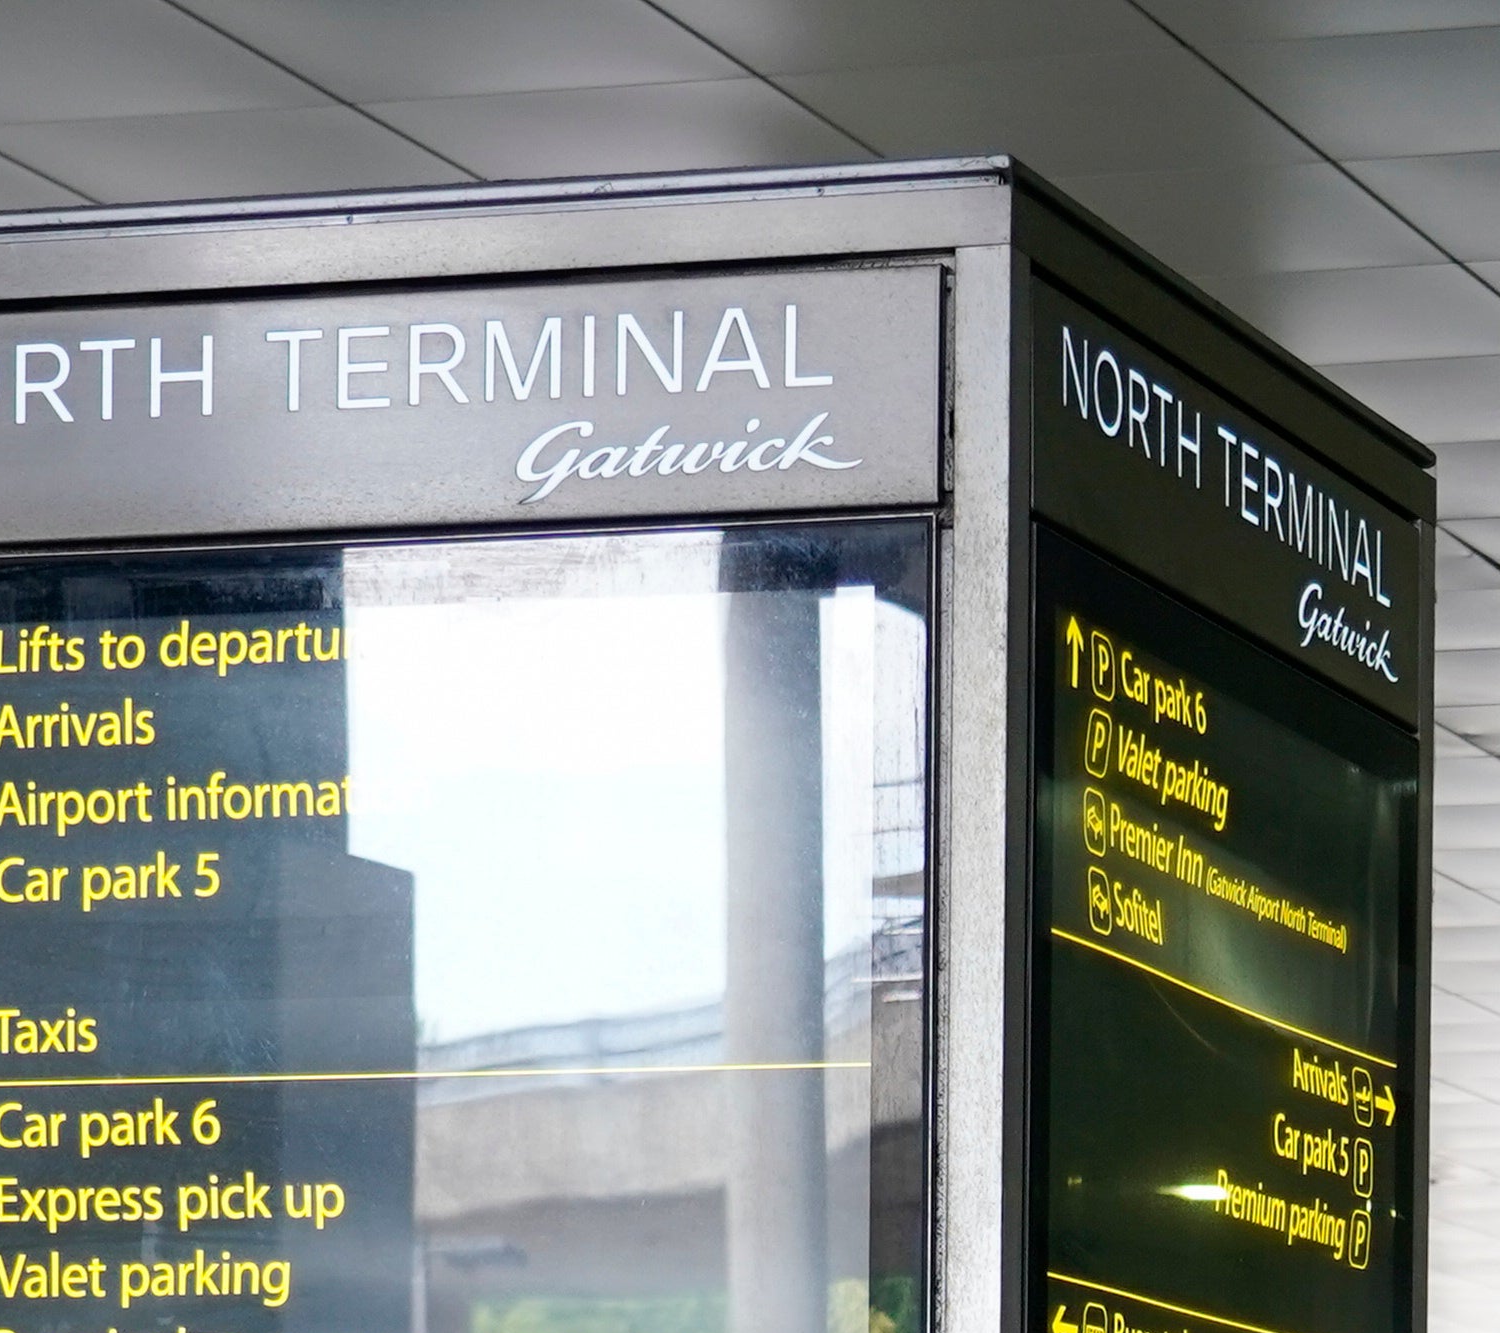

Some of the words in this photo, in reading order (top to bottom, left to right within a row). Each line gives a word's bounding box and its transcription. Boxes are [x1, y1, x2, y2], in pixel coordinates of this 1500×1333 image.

[266, 305, 833, 411] TERMINAL
[516, 412, 863, 502] Gatwick
[1062, 326, 1201, 489] NORTH
[1217, 426, 1391, 608] TERMINAL
[99, 630, 146, 669] to
[1298, 582, 1399, 683] Gatwick
[1120, 650, 1151, 705] Car
[1153, 678, 1193, 727] park
[1194, 691, 1207, 735] 6
[1117, 725, 1163, 790] Valet
[1160, 760, 1229, 832] parking
[81, 851, 181, 911] park
[195, 851, 221, 897] 5
[1106, 801, 1178, 875] Premier
[1175, 834, 1204, 889] Inn
[1245, 884, 1281, 923] Airport
[1279, 899, 1307, 934] North
[1112, 880, 1166, 945] Sofitel
[1292, 1047, 1350, 1106] Arrivals
[79, 1097, 181, 1157] park
[190, 1098, 221, 1145] 6
[1273, 1112, 1301, 1161] Car
[1302, 1128, 1338, 1174] park
[1338, 1137, 1350, 1177] 5
[176, 1170, 272, 1230] pick
[283, 1182, 345, 1228] up
[1214, 1168, 1287, 1232] Premium
[1287, 1199, 1347, 1260] parking
[119, 1249, 291, 1308] parking
